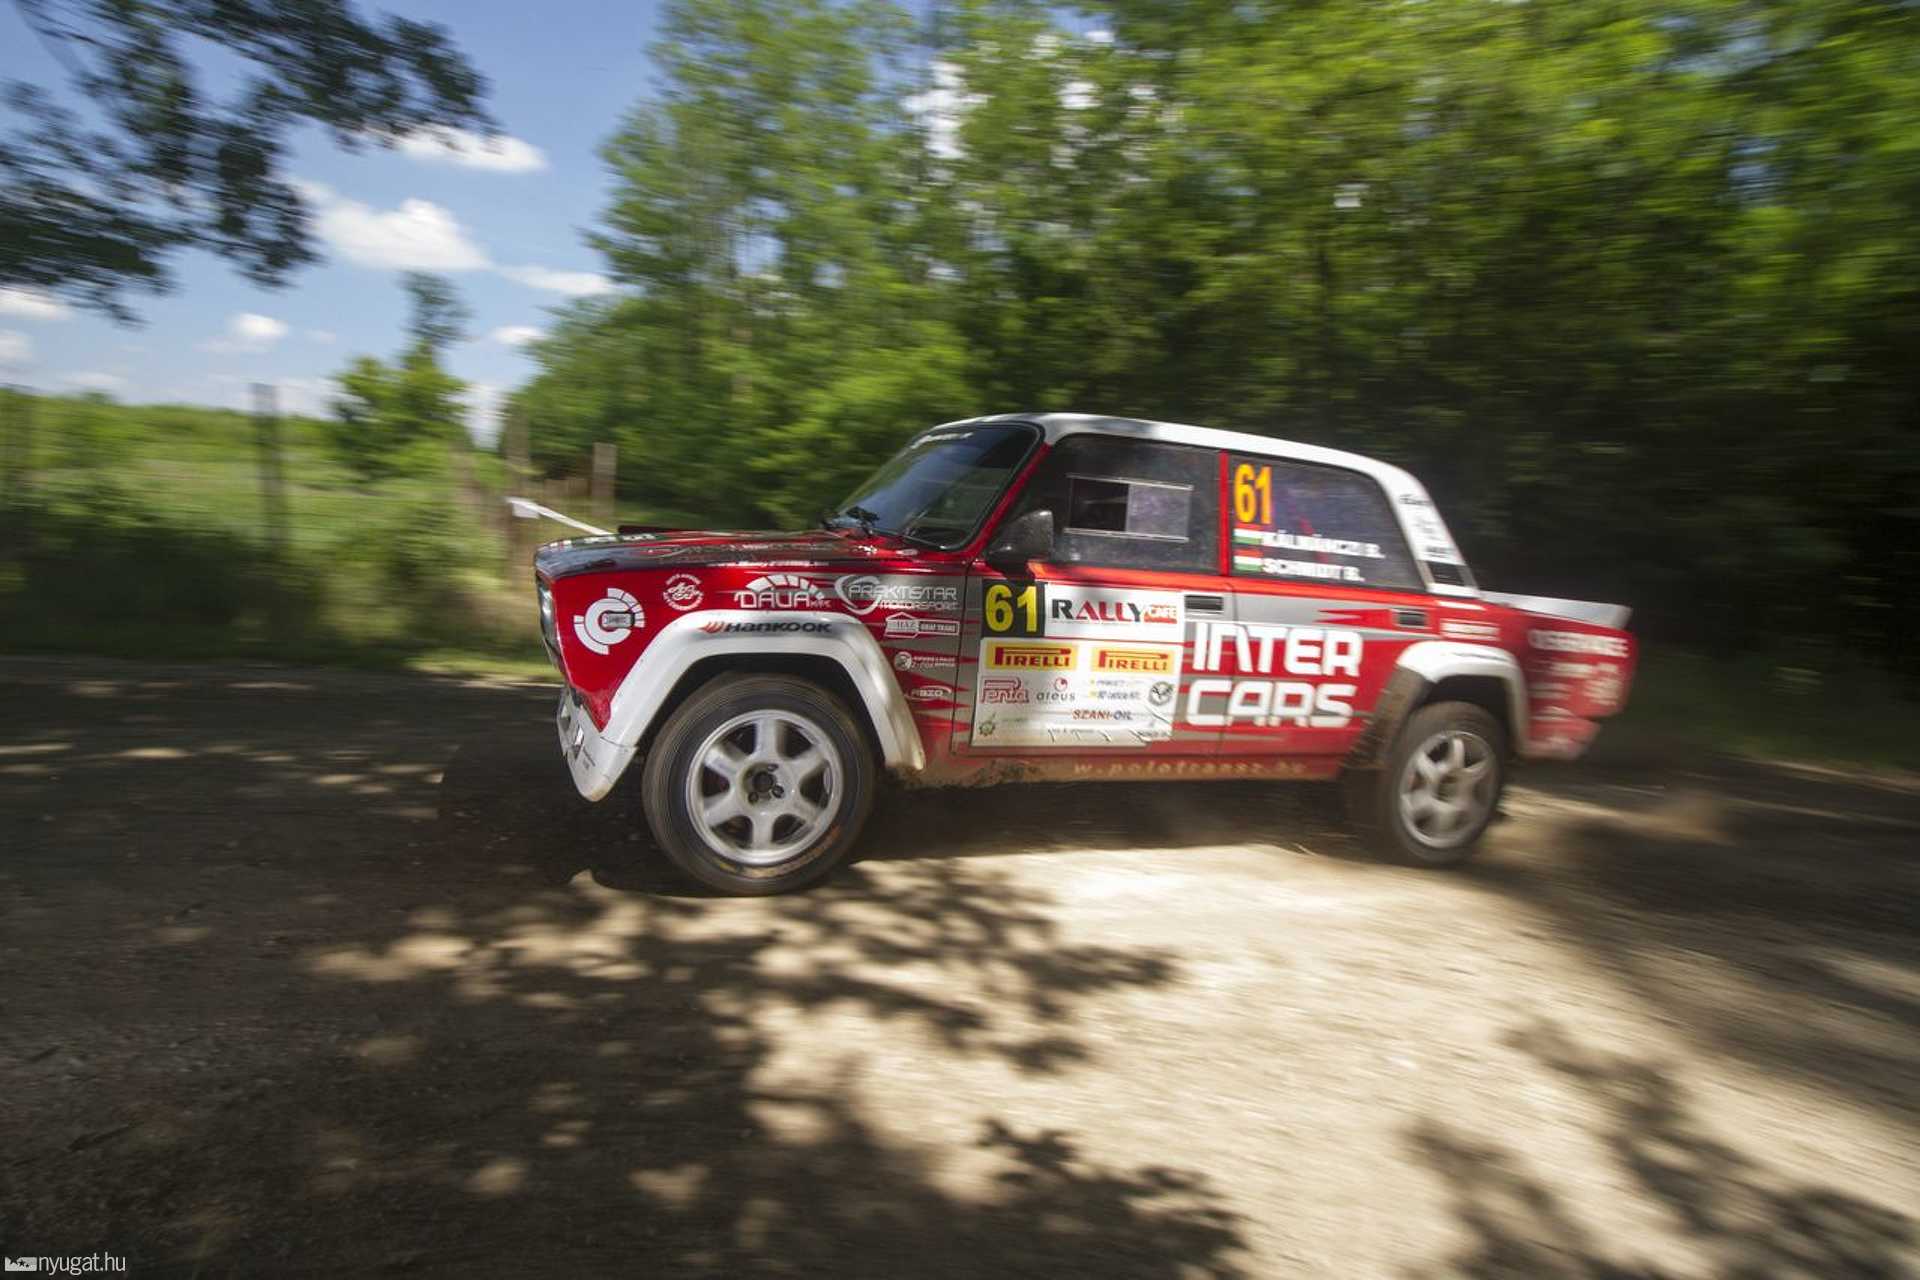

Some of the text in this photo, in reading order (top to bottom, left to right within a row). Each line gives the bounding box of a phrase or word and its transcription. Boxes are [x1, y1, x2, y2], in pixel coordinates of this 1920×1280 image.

[1233, 463, 1272, 524] 61
[985, 584, 1038, 633] 61
[1052, 599, 1140, 622] RALLY
[994, 647, 1072, 668] PIRELLI
[1098, 650, 1169, 671] PIRELLI
[1192, 623, 1363, 676] INTER
[1186, 679, 1358, 728] CARS
